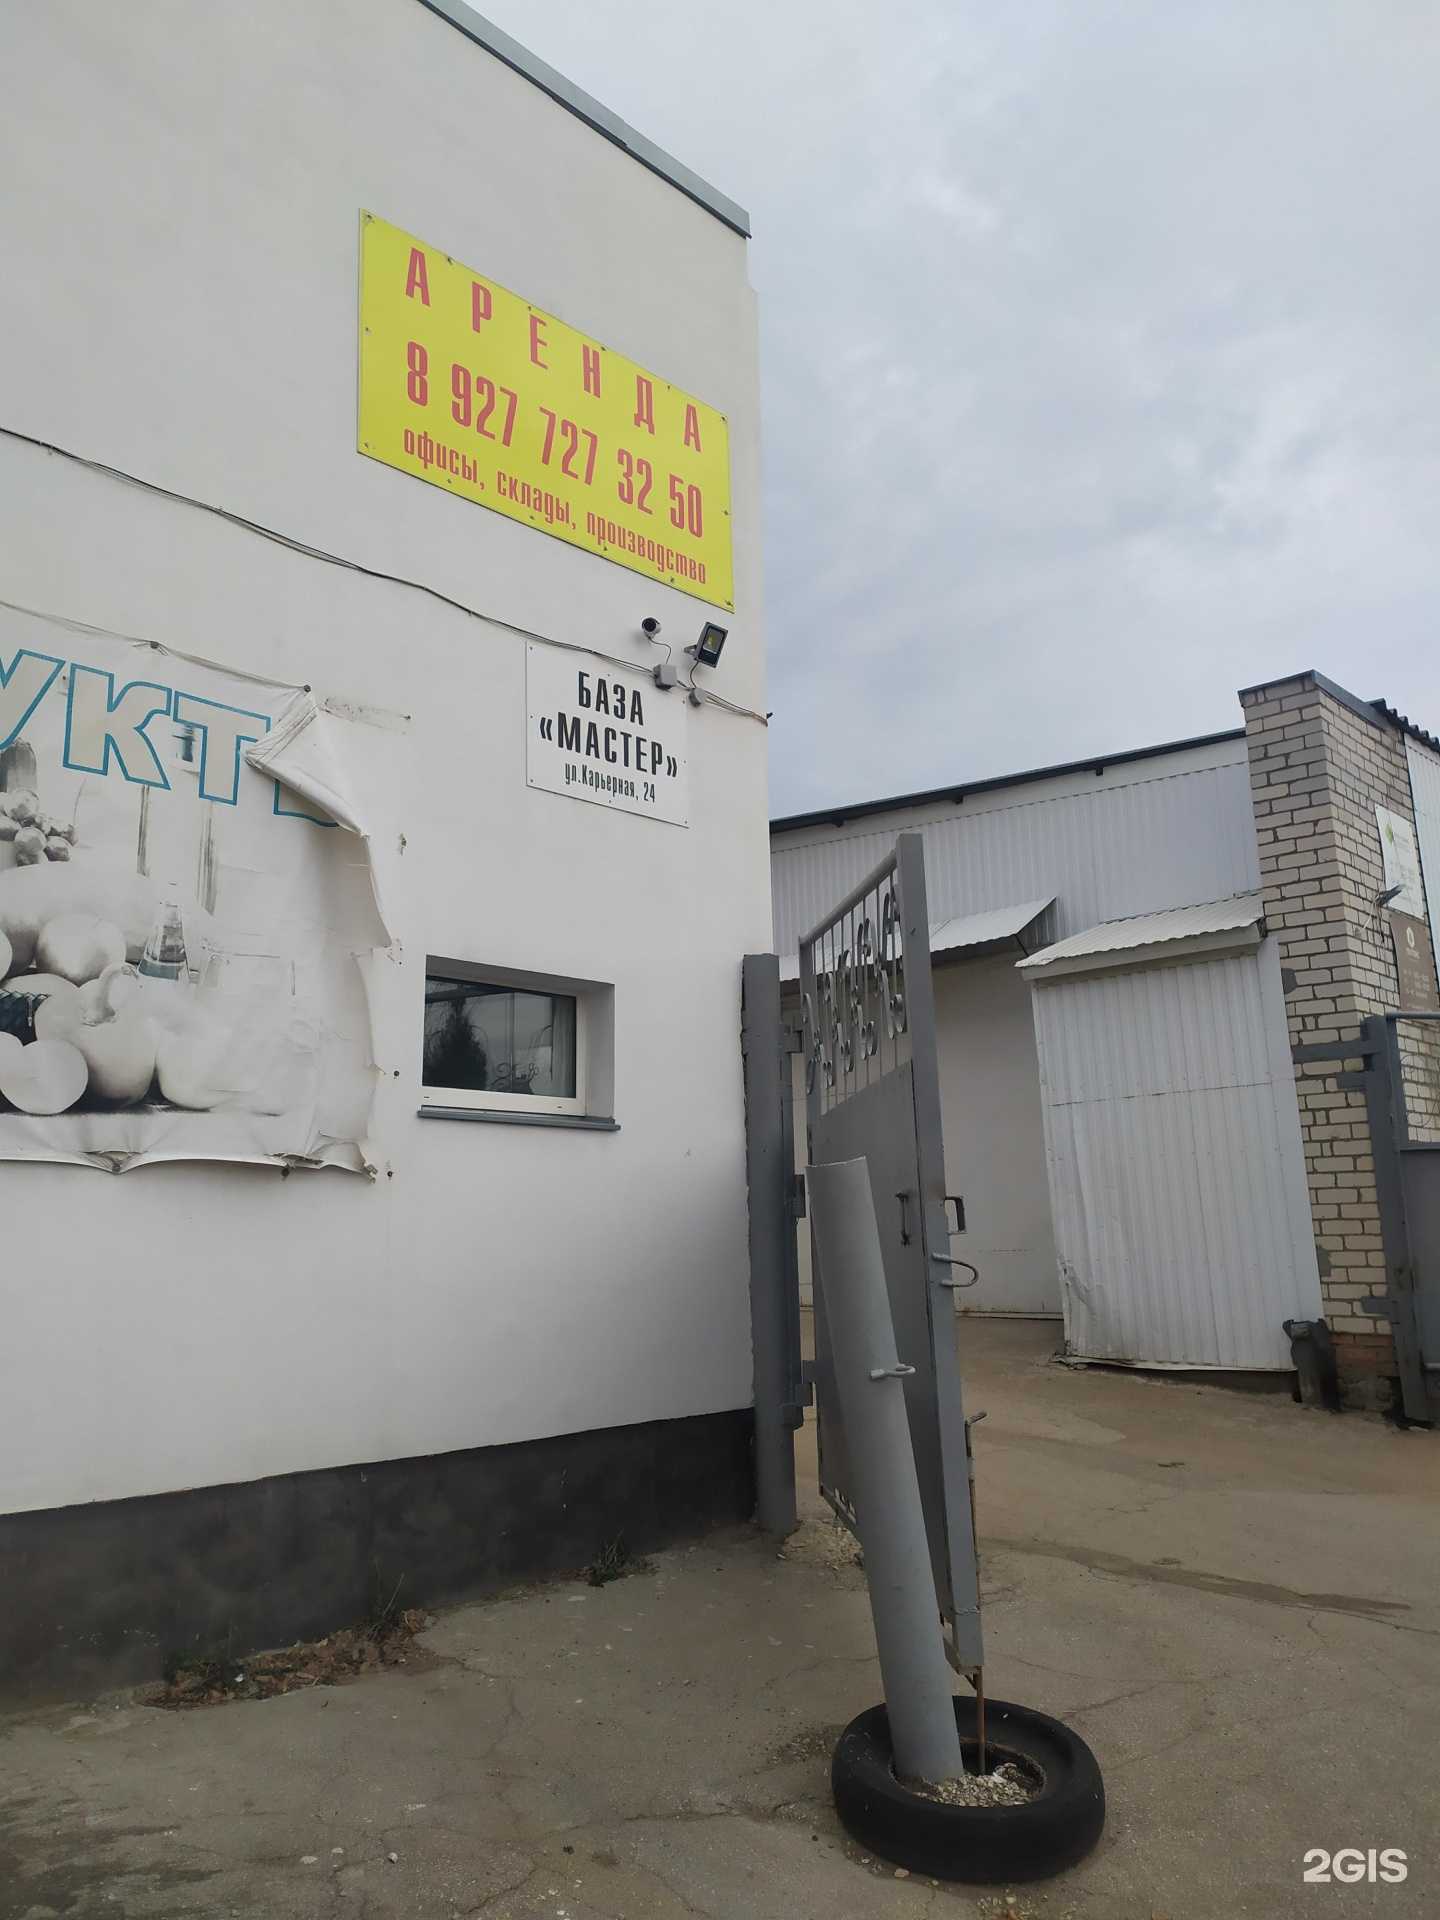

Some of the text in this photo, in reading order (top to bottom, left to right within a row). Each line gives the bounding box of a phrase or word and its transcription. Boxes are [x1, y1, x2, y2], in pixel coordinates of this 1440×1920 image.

[405, 247, 702, 453] АРЕНДА
[406, 340, 704, 539] 8 927 727 32 50
[404, 429, 706, 585] офисы, склады, производство
[540, 712, 678, 778] «МАСТЕР»
[578, 671, 644, 726] БАЗА
[643, 782, 656, 803] 24
